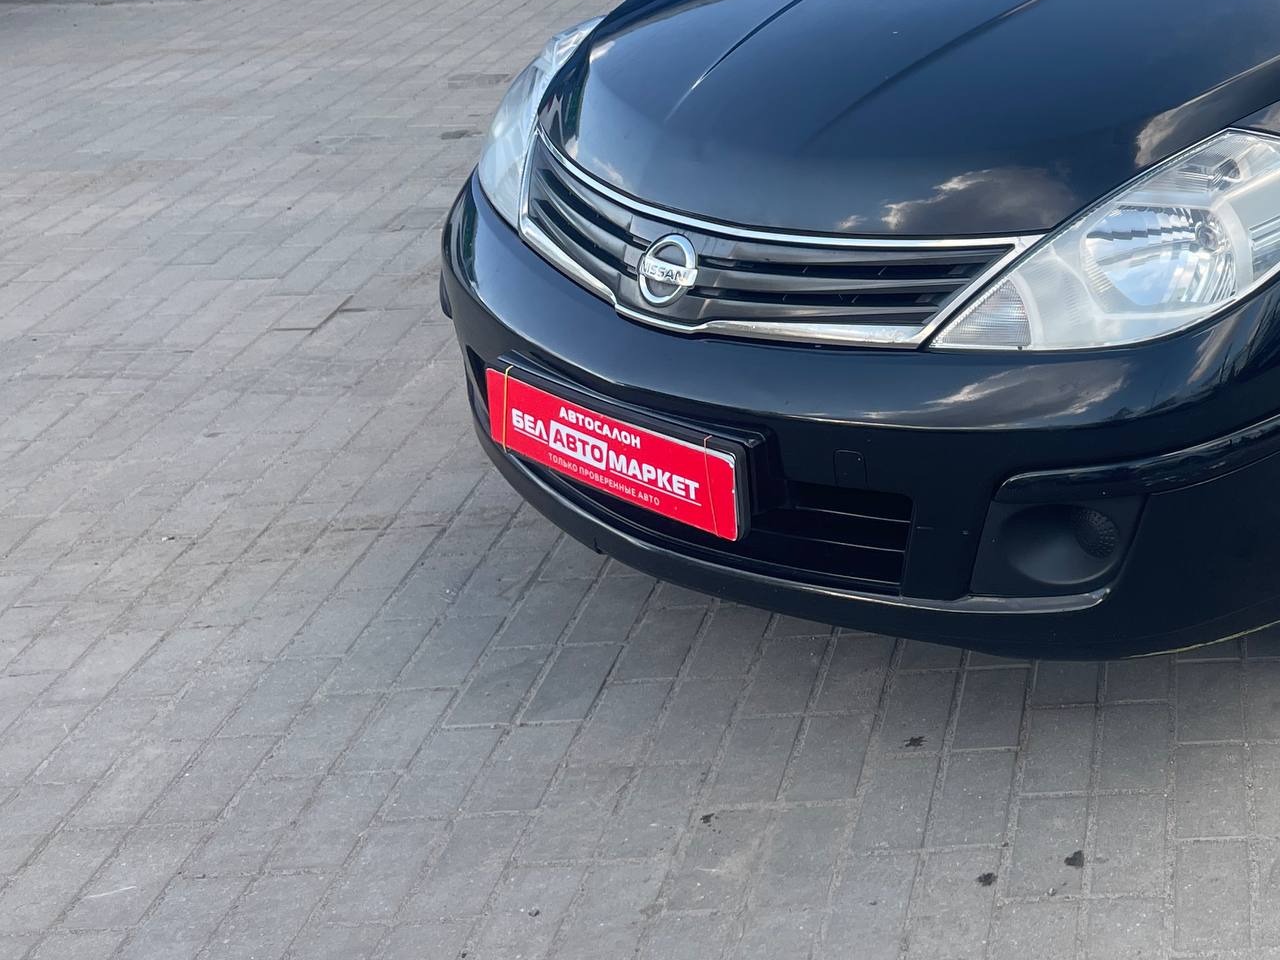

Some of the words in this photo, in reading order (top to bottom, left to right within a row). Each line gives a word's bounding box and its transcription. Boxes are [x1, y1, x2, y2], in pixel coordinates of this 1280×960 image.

[641, 259, 690, 283] NISSAN
[559, 406, 641, 449] АВТОСАЛОН
[511, 407, 549, 441] БЕЛ
[552, 427, 604, 464] АВТО
[608, 449, 700, 501] МАРКЕТ
[547, 452, 578, 473] ТОЛЬКО
[579, 466, 637, 498] ПРОВЕРЕННЫЕ
[637, 490, 660, 507] АВТО
